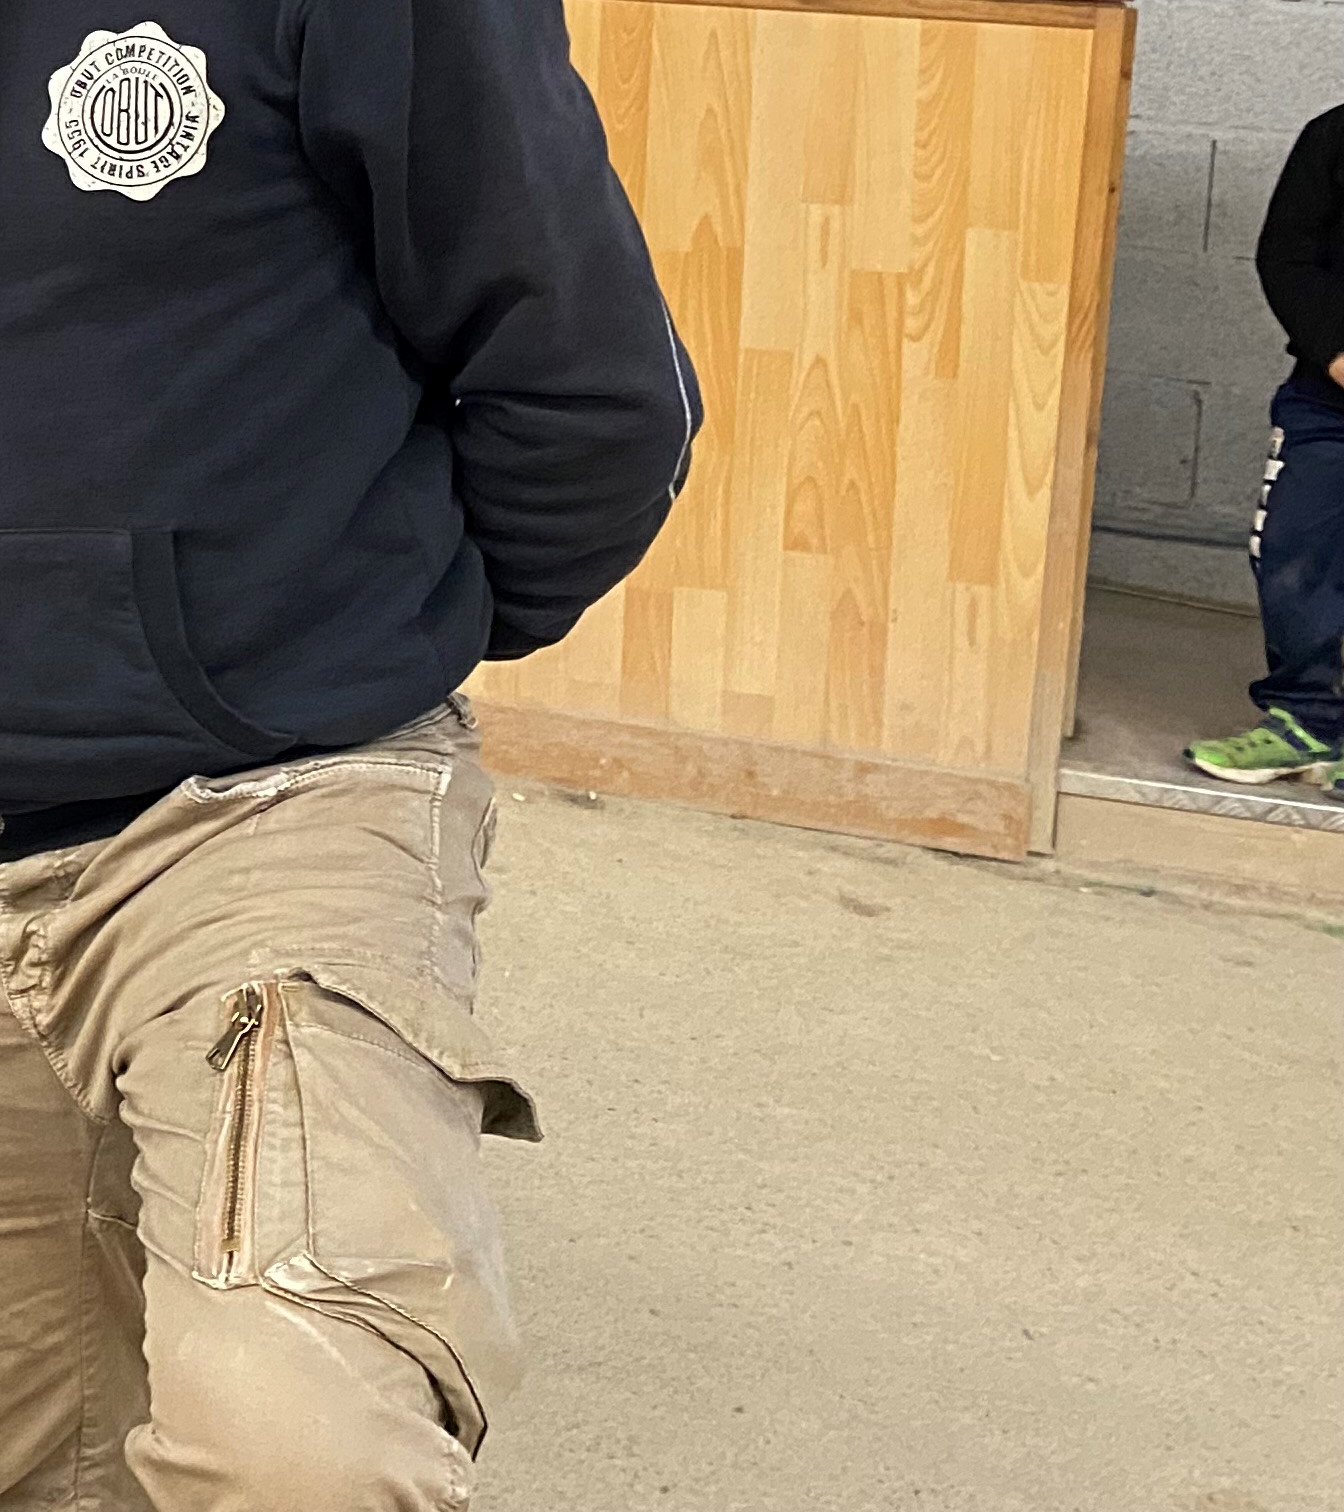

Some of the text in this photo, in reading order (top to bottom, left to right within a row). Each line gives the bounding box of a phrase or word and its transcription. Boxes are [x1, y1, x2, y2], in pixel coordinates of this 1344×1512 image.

[104, 43, 198, 96] COMPETITION
[100, 76, 164, 146] OBUT
[64, 119, 90, 159] 1955
[89, 156, 146, 180] SPIRIT
